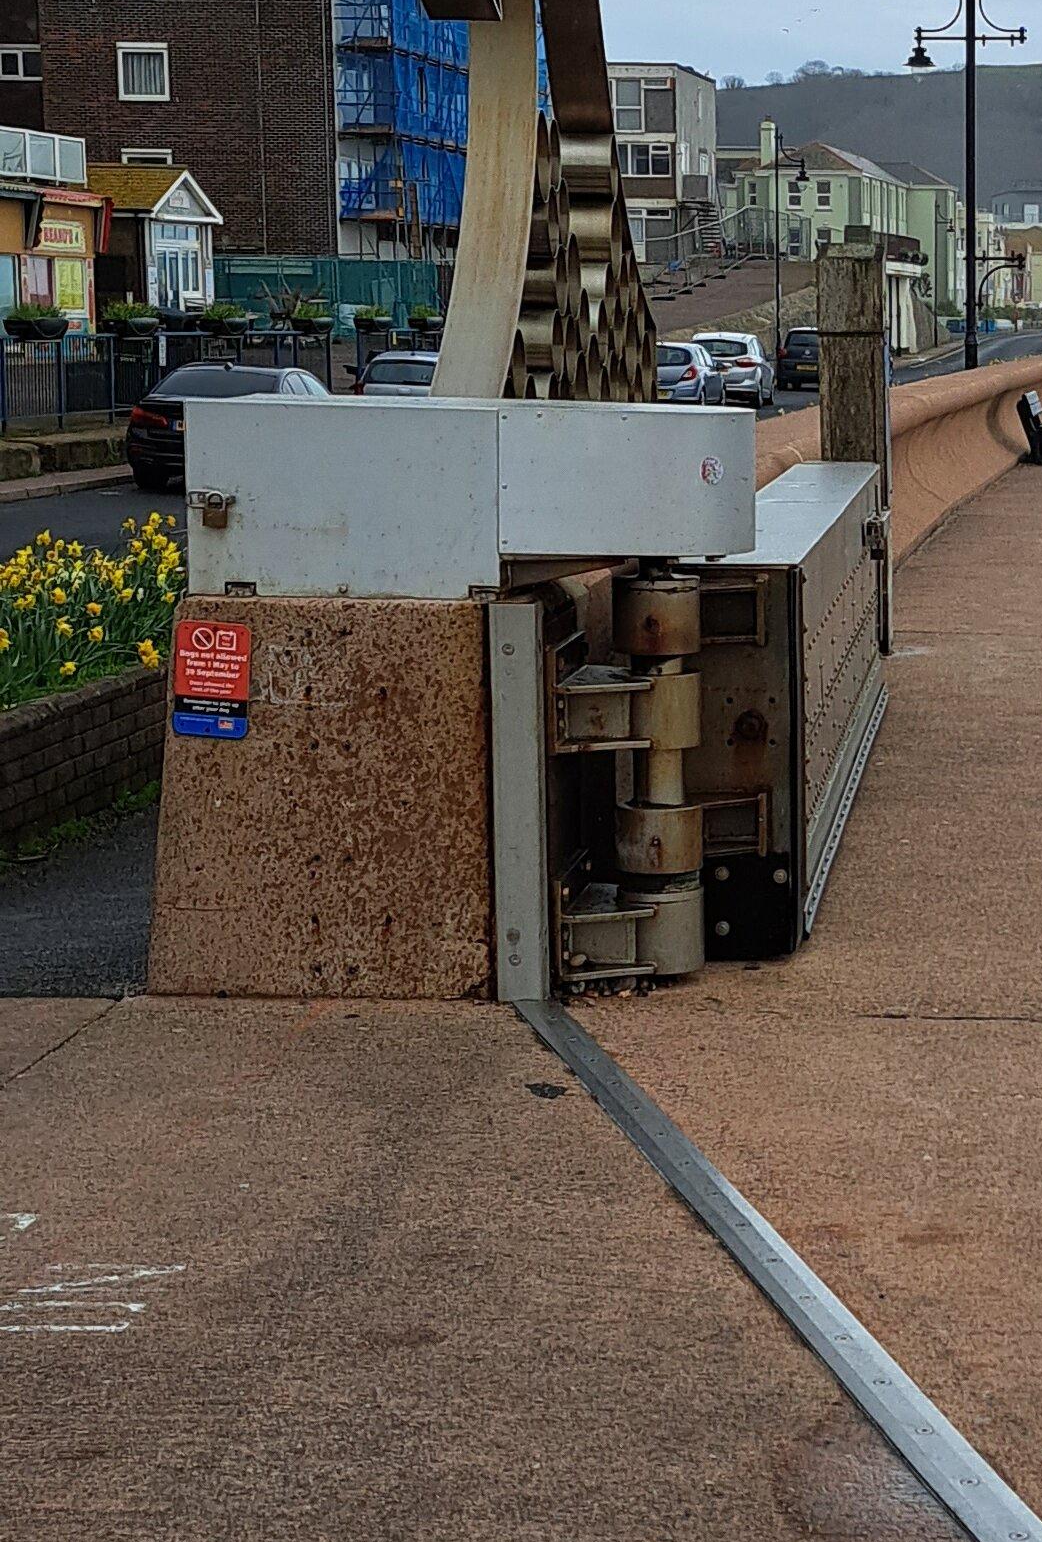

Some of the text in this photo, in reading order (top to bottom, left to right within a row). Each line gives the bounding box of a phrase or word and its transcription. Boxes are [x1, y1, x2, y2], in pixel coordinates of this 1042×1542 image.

[179, 649, 200, 659] Dogs
[216, 652, 248, 662] allowed
[186, 659, 206, 667] from
[213, 661, 230, 670] May
[196, 669, 241, 679] September
